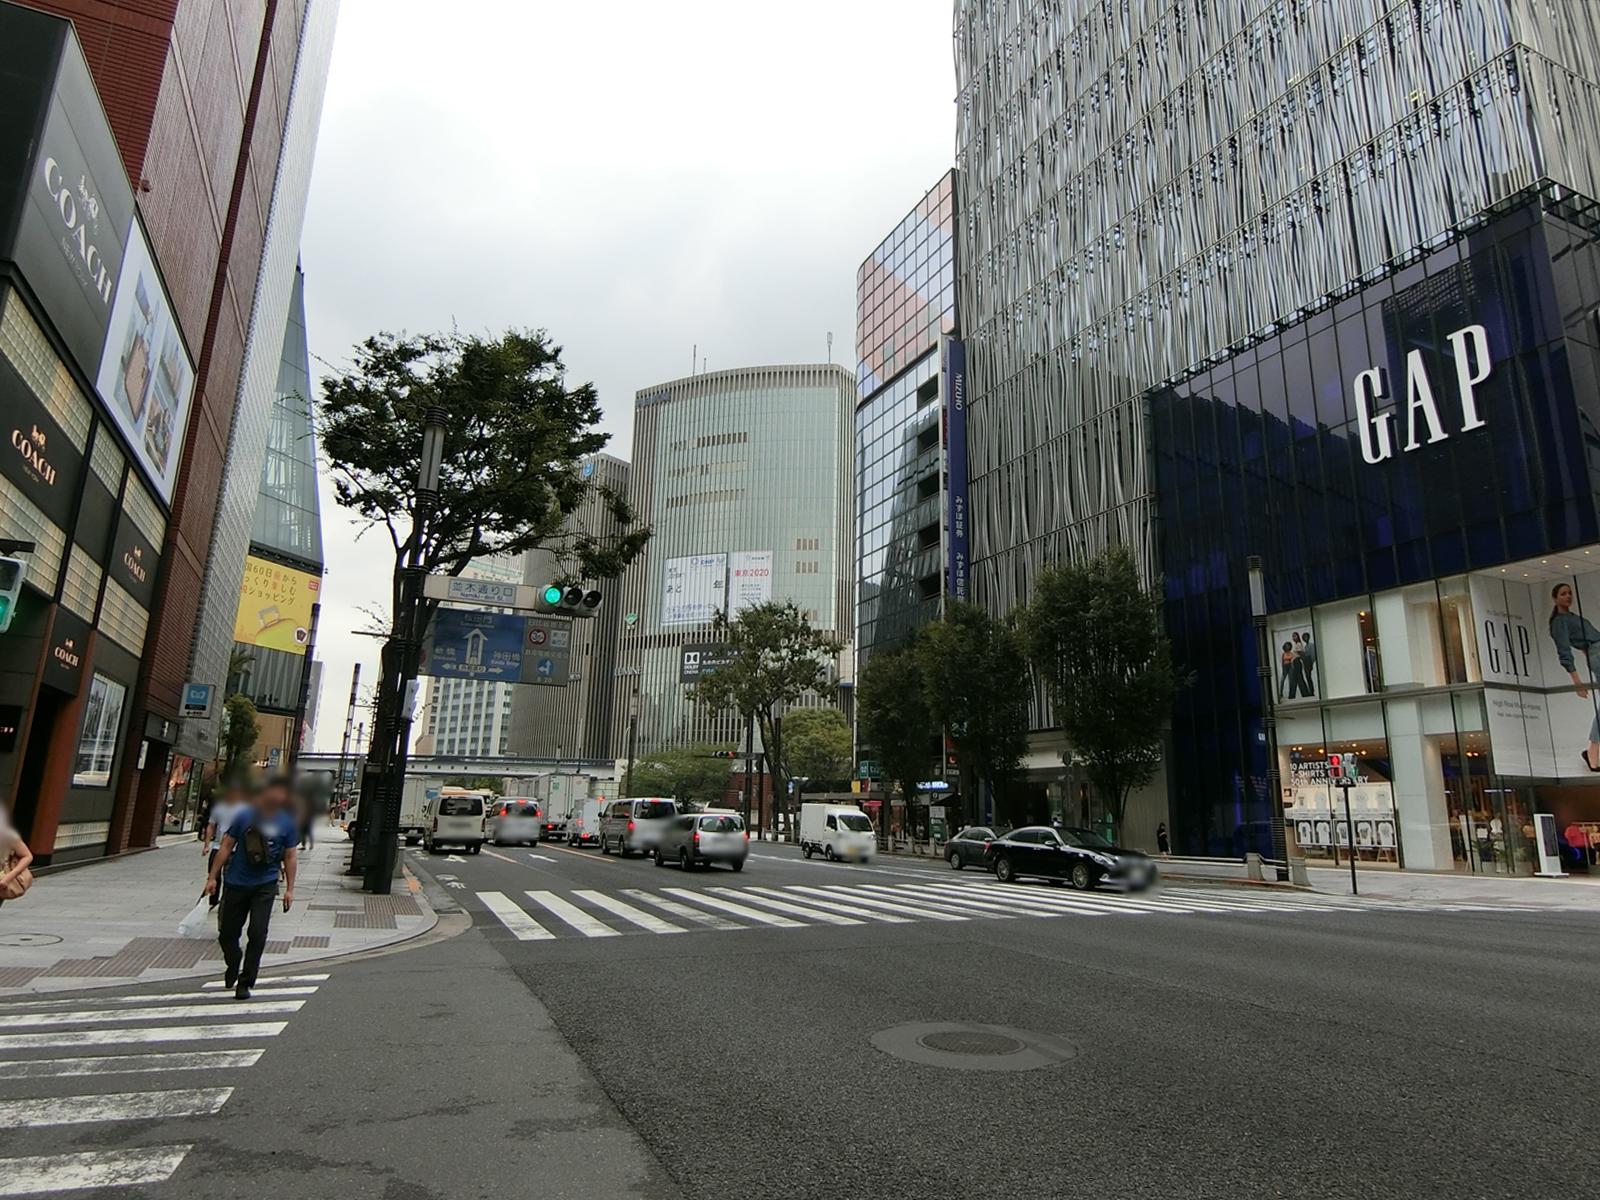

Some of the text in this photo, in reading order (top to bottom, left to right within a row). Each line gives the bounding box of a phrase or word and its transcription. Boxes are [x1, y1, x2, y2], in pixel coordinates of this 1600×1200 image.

[45, 157, 112, 305] COACH
[955, 372, 963, 411] MIZUHO
[1354, 325, 1491, 464] GAP
[12, 429, 56, 485] COACH
[955, 495, 964, 538] みずほ証券
[124, 552, 146, 582] COACH
[735, 568, 769, 577] 東京2020
[452, 581, 513, 597] 並木通り口
[464, 613, 493, 624] 桜田門
[54, 646, 79, 667] COACH
[434, 646, 456, 656] 新橋
[493, 651, 520, 661] 神田橋
[1484, 620, 1530, 677] GAP
[1291, 770, 1325, 778] T-SHIRTS
[1291, 778, 1309, 786] 50th
